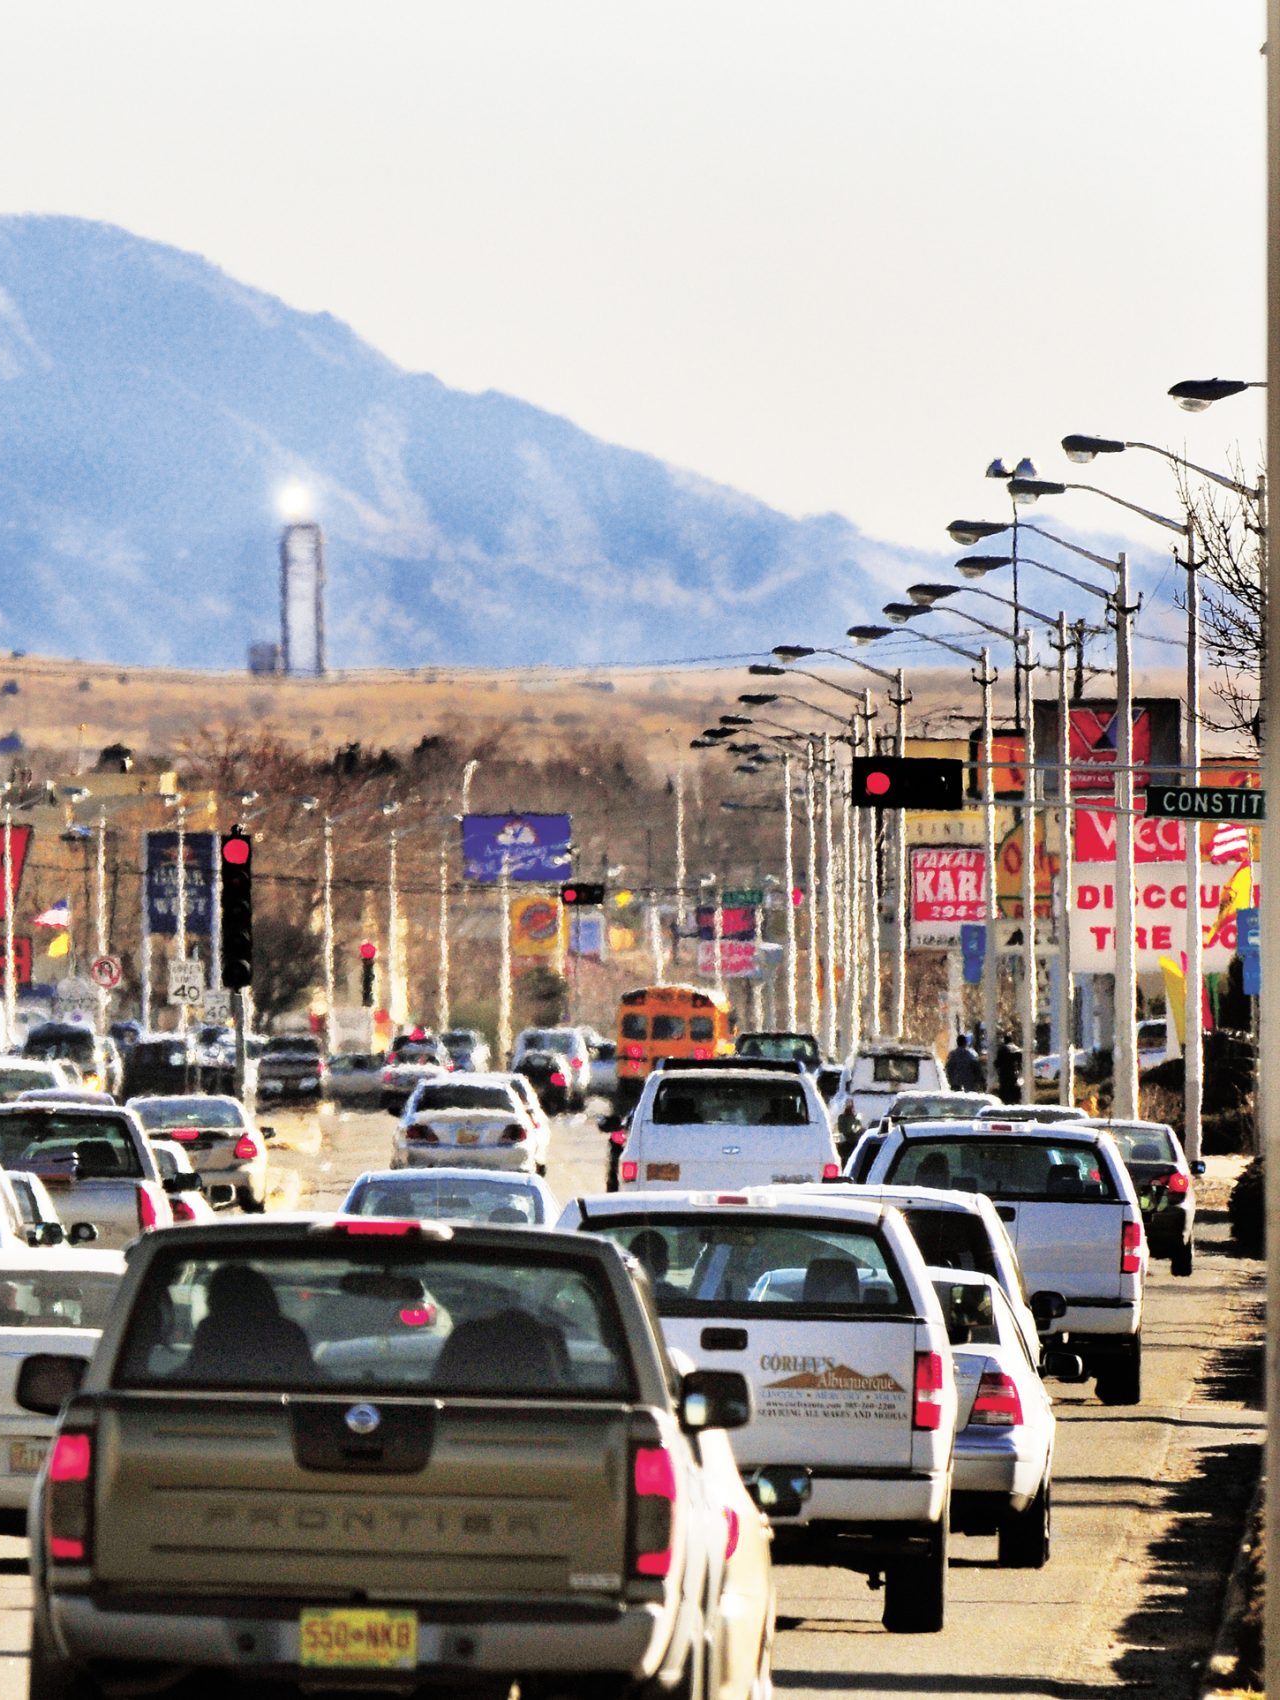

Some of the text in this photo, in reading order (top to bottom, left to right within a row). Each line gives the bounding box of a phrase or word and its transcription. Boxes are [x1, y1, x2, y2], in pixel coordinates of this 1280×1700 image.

[1163, 790, 1265, 816] CONSTIT
[173, 984, 200, 1001] 40
[817, 1372, 895, 1391] Albuquerque
[854, 1411, 872, 1420] AND
[206, 1507, 540, 1534] FRONTIER
